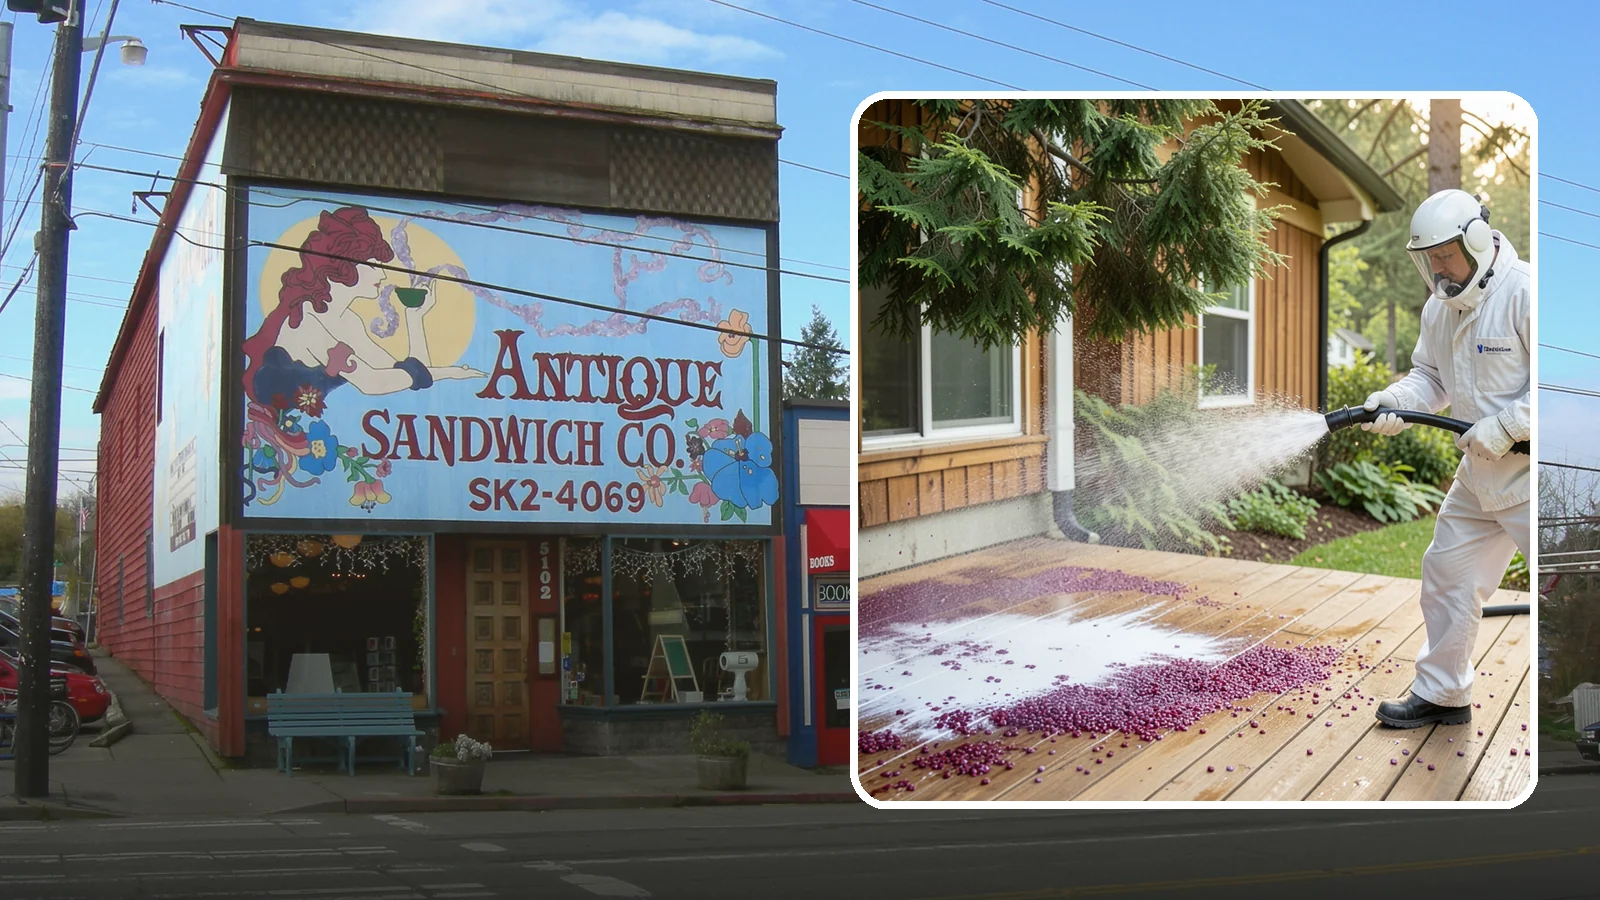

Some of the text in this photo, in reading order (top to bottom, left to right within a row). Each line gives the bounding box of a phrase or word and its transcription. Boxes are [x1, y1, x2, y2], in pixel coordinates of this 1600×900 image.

[476, 328, 724, 421] ANTIQUE
[361, 408, 685, 469] SANDWICH CO.
[468, 477, 646, 514] SK2-4069
[539, 542, 551, 599] 5102
[809, 555, 835, 569] BOOKS
